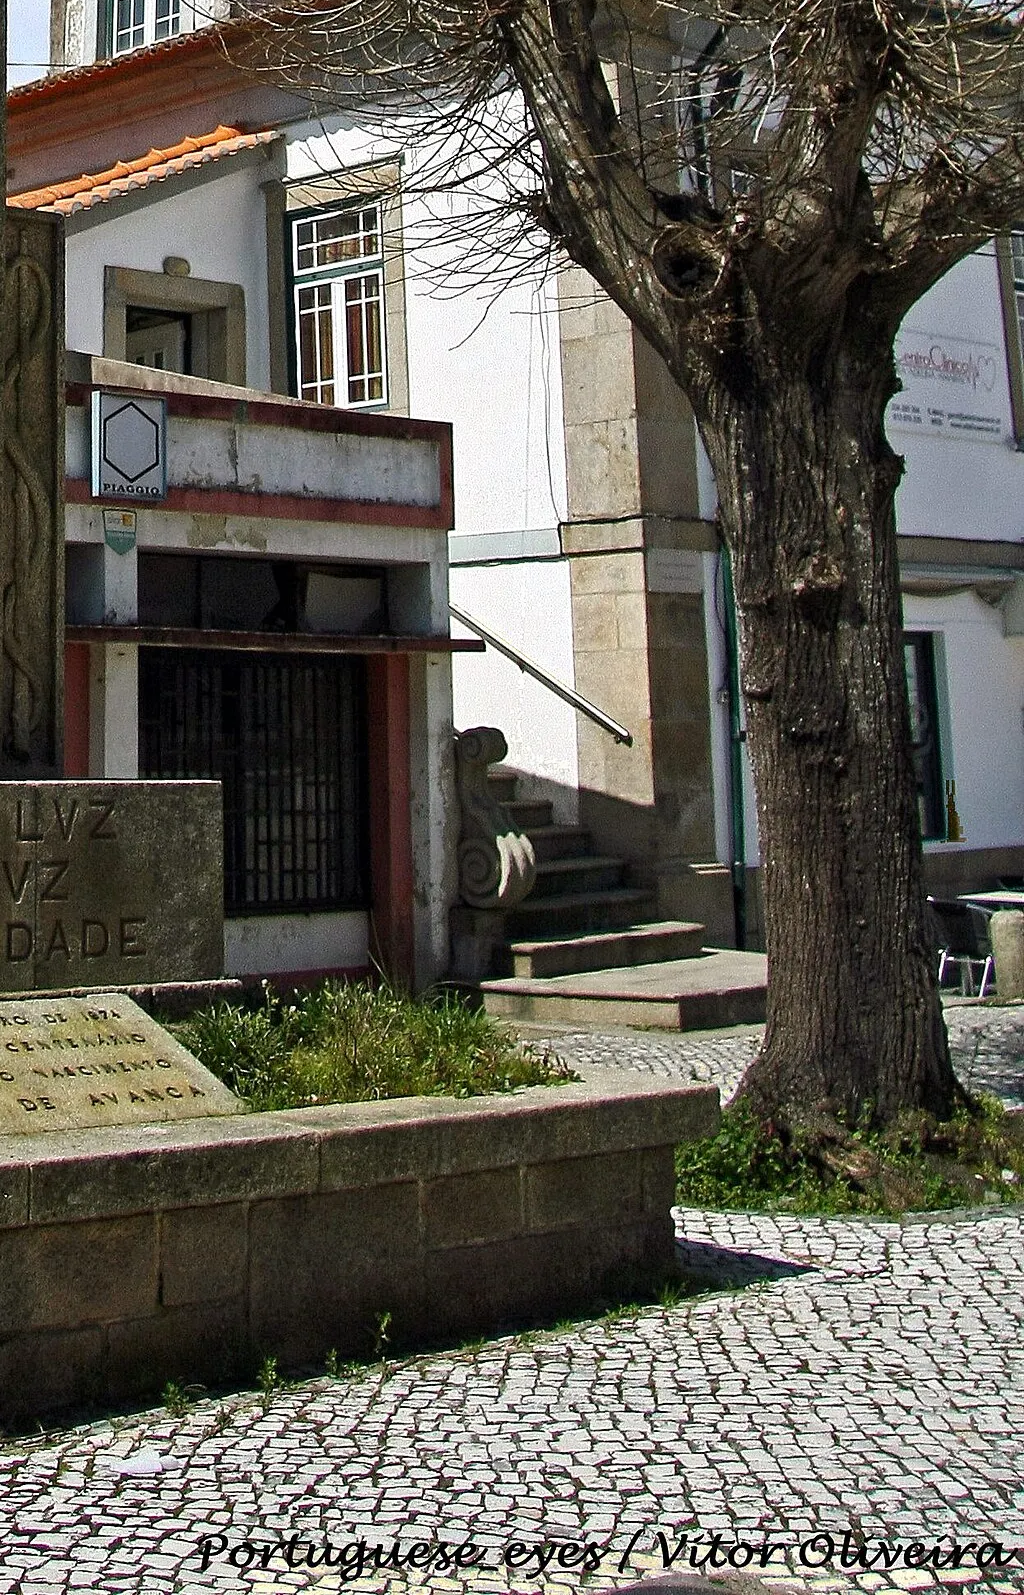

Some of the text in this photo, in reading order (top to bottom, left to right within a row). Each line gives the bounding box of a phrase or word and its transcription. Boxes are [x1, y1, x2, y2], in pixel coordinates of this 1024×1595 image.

[103, 483, 159, 495] PIAGGIO
[15, 799, 118, 844] LVZ
[42, 1012, 68, 1024] DE
[80, 1008, 122, 1022] 1874
[32, 1058, 172, 1079] NASCIMENTO
[17, 1095, 57, 1112] DE
[88, 1083, 206, 1107] AVANCA
